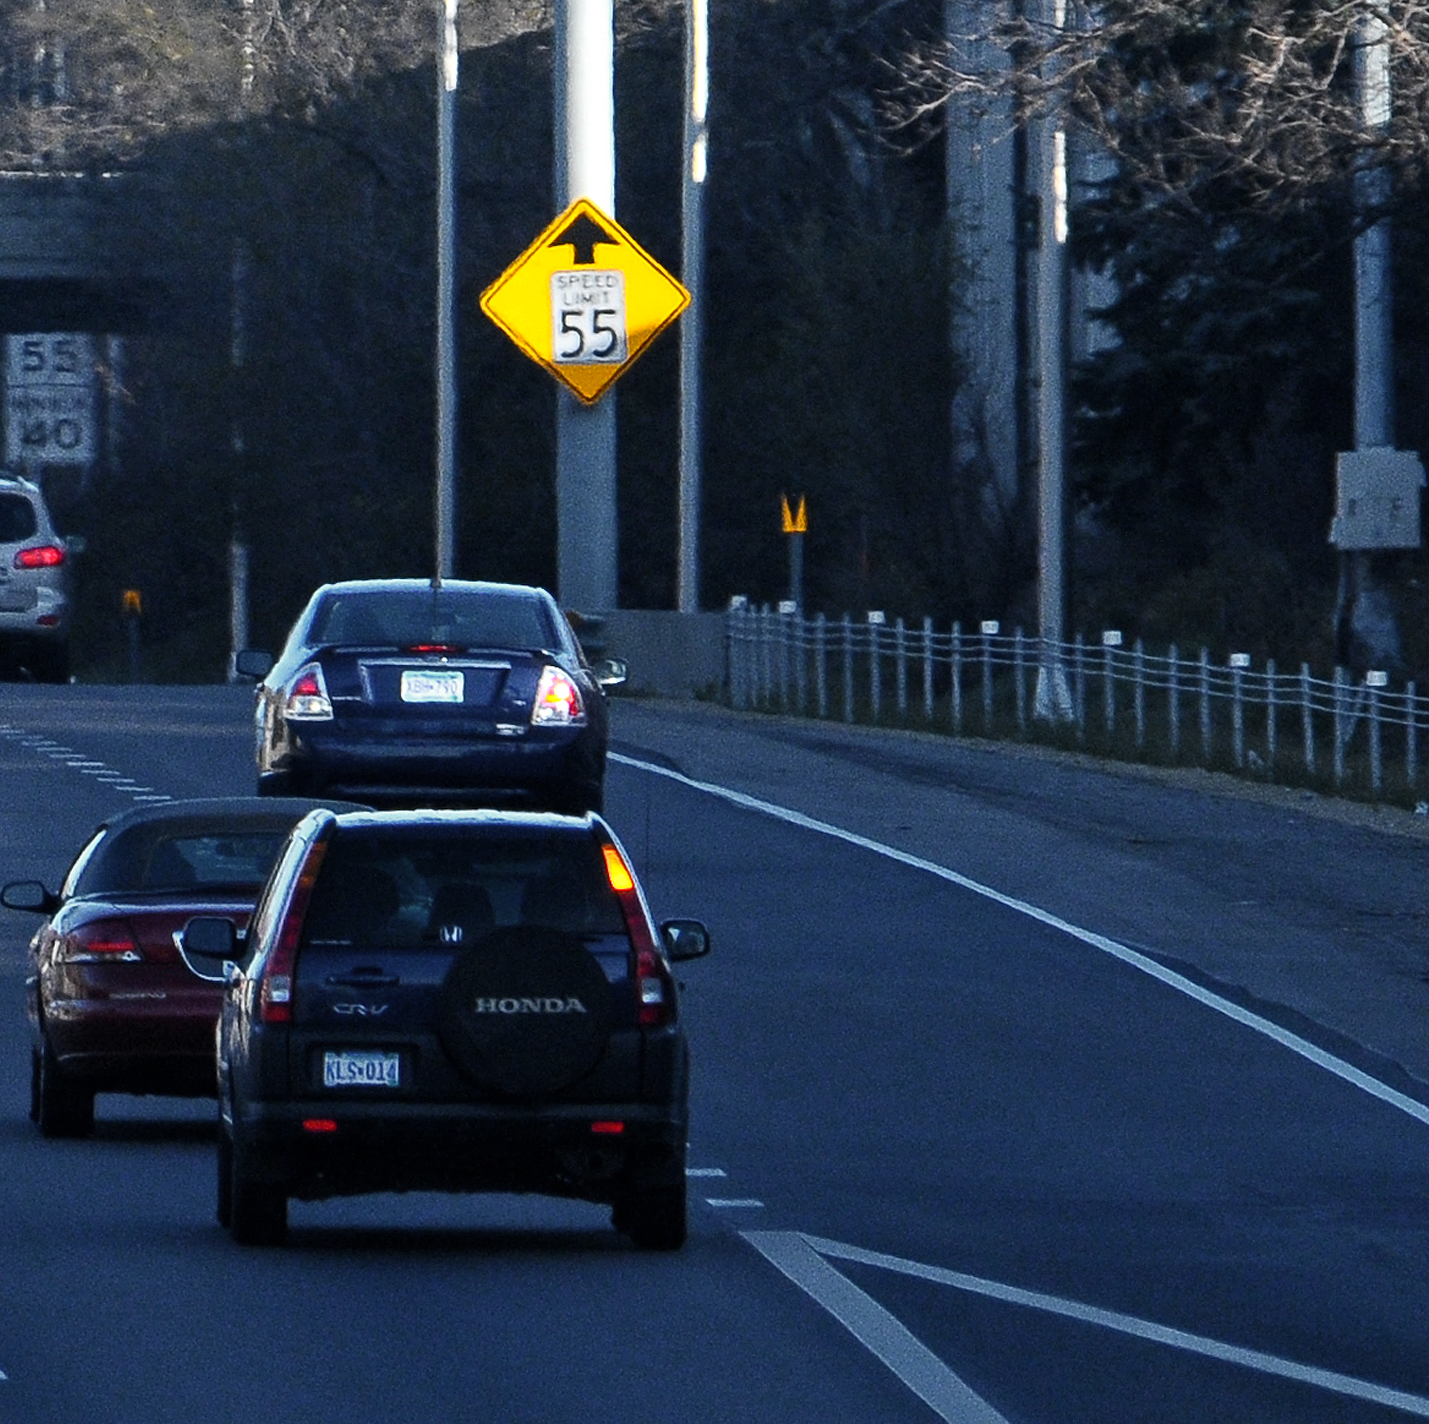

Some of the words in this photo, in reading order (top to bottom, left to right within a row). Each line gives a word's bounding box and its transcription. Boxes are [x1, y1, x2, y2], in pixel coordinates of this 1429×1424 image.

[557, 275, 618, 288] SPEED
[563, 291, 608, 306] LIMIT
[561, 309, 617, 358] 55
[22, 340, 79, 372] 55
[475, 998, 587, 1014] HONDA
